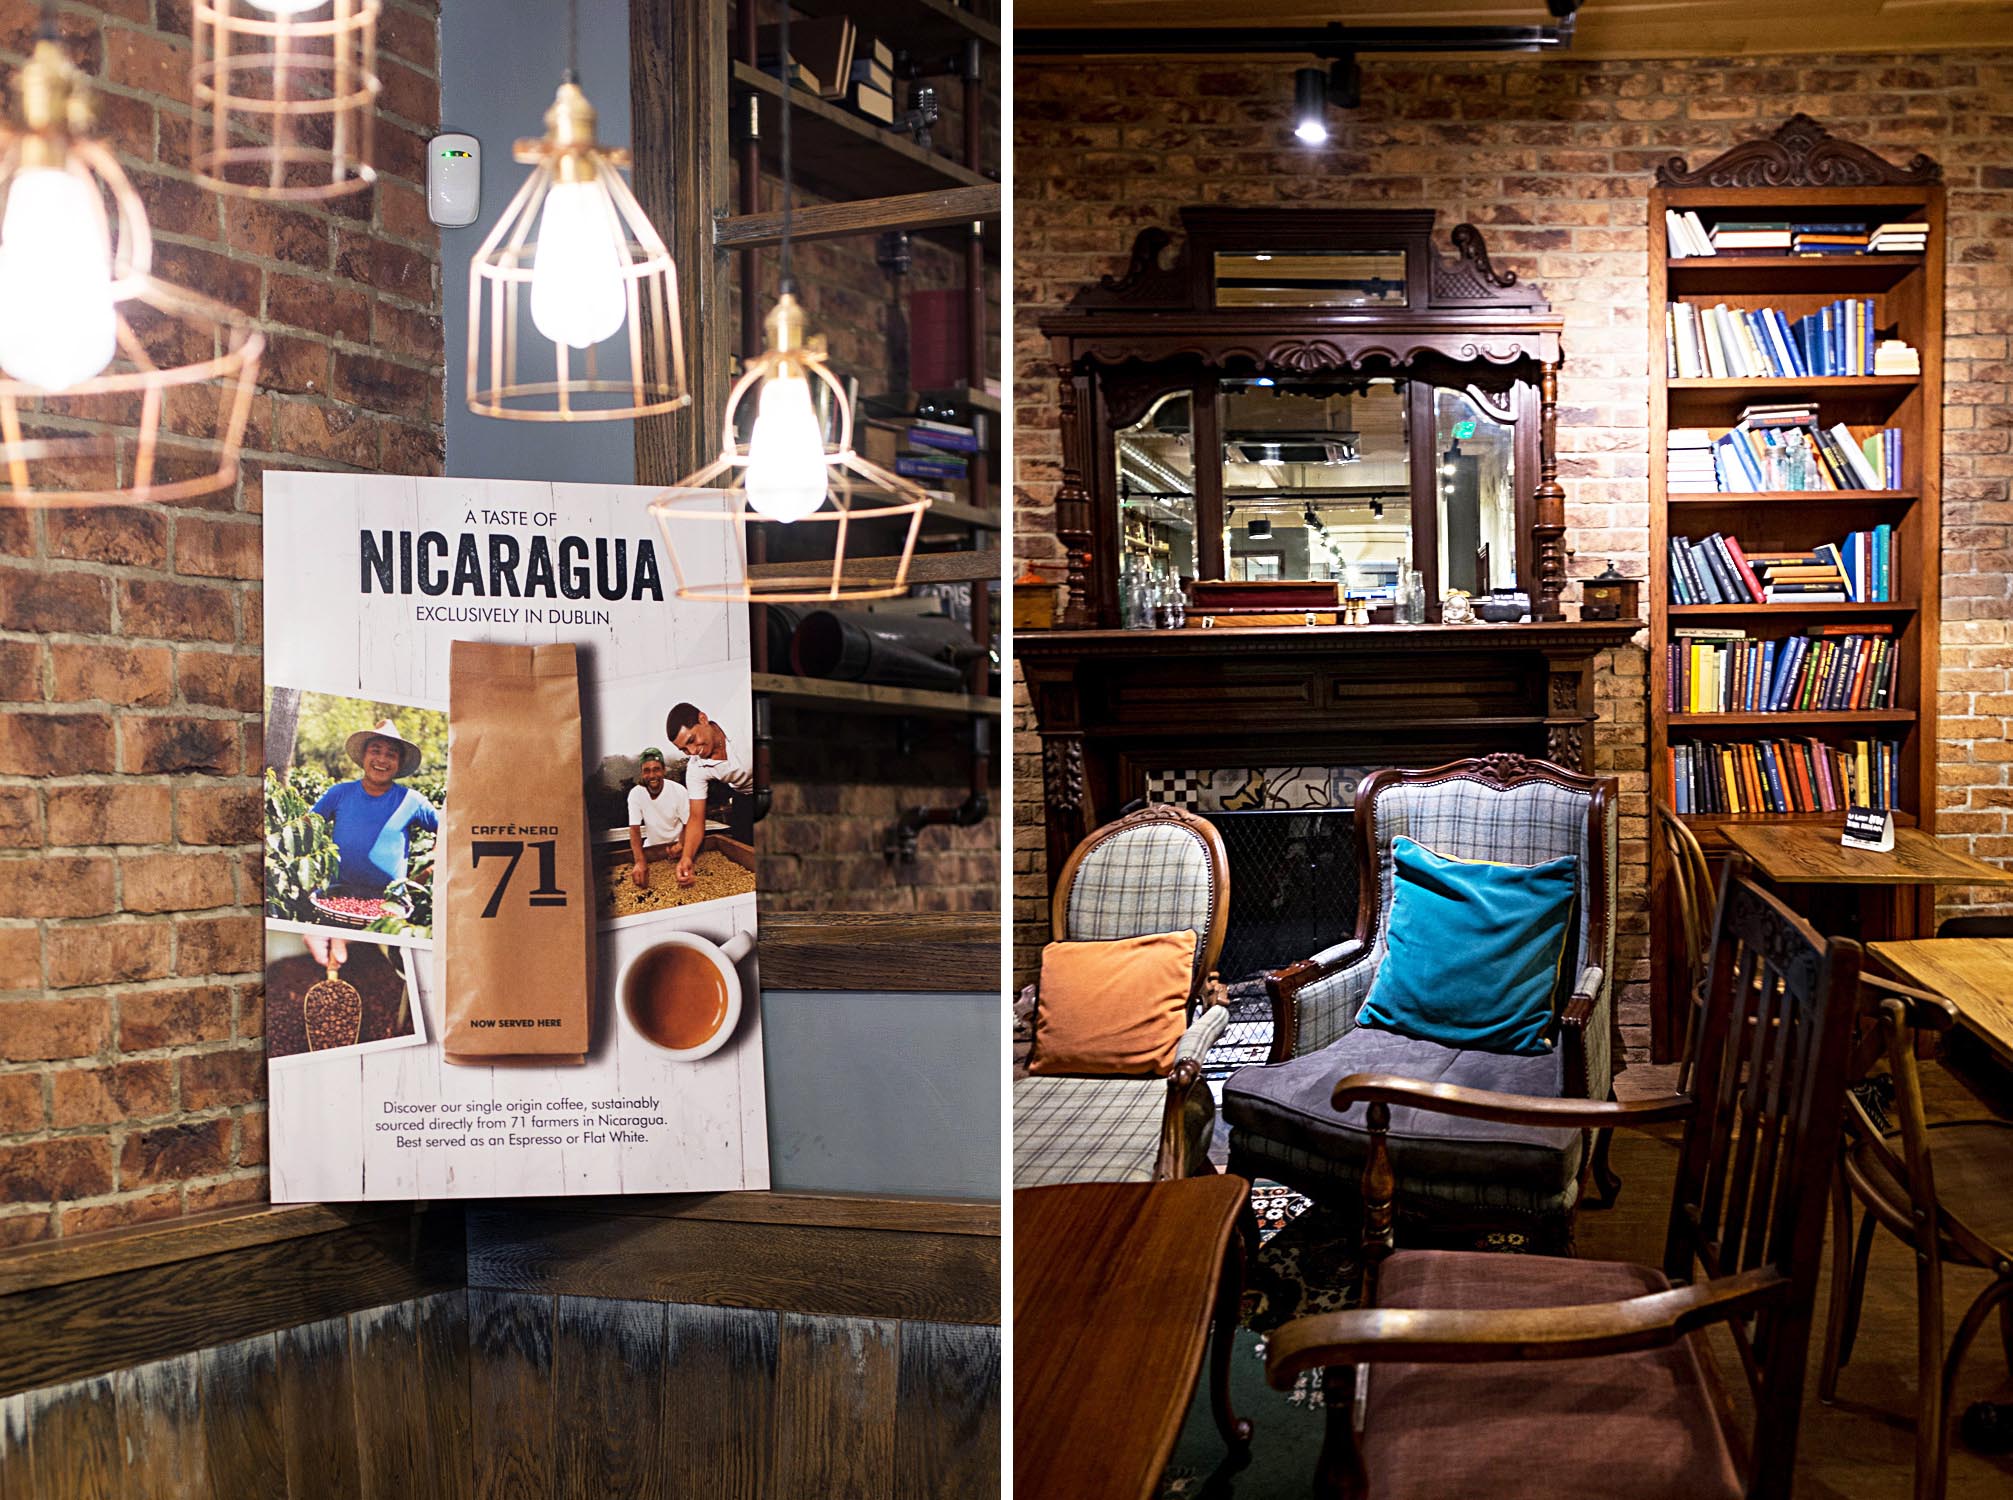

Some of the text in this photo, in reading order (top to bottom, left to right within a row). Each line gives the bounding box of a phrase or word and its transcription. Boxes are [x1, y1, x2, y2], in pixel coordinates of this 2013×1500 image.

[464, 509, 557, 527] A TASTE OF
[360, 529, 664, 602] NICARAGUA
[416, 606, 611, 626] EXCLUSIVELY IN DUBLIN
[471, 821, 559, 836] CAFFÈ NERO
[471, 839, 568, 919] 71
[470, 1018, 562, 1029] NOW SERVED HERE
[383, 1095, 660, 1115] Discover our single origin coffee, sustainably
[375, 1114, 669, 1133] sourced directly from 71 farmers in Nicaragua.
[396, 1130, 650, 1148] Best served as an Espresso or Flat White.
